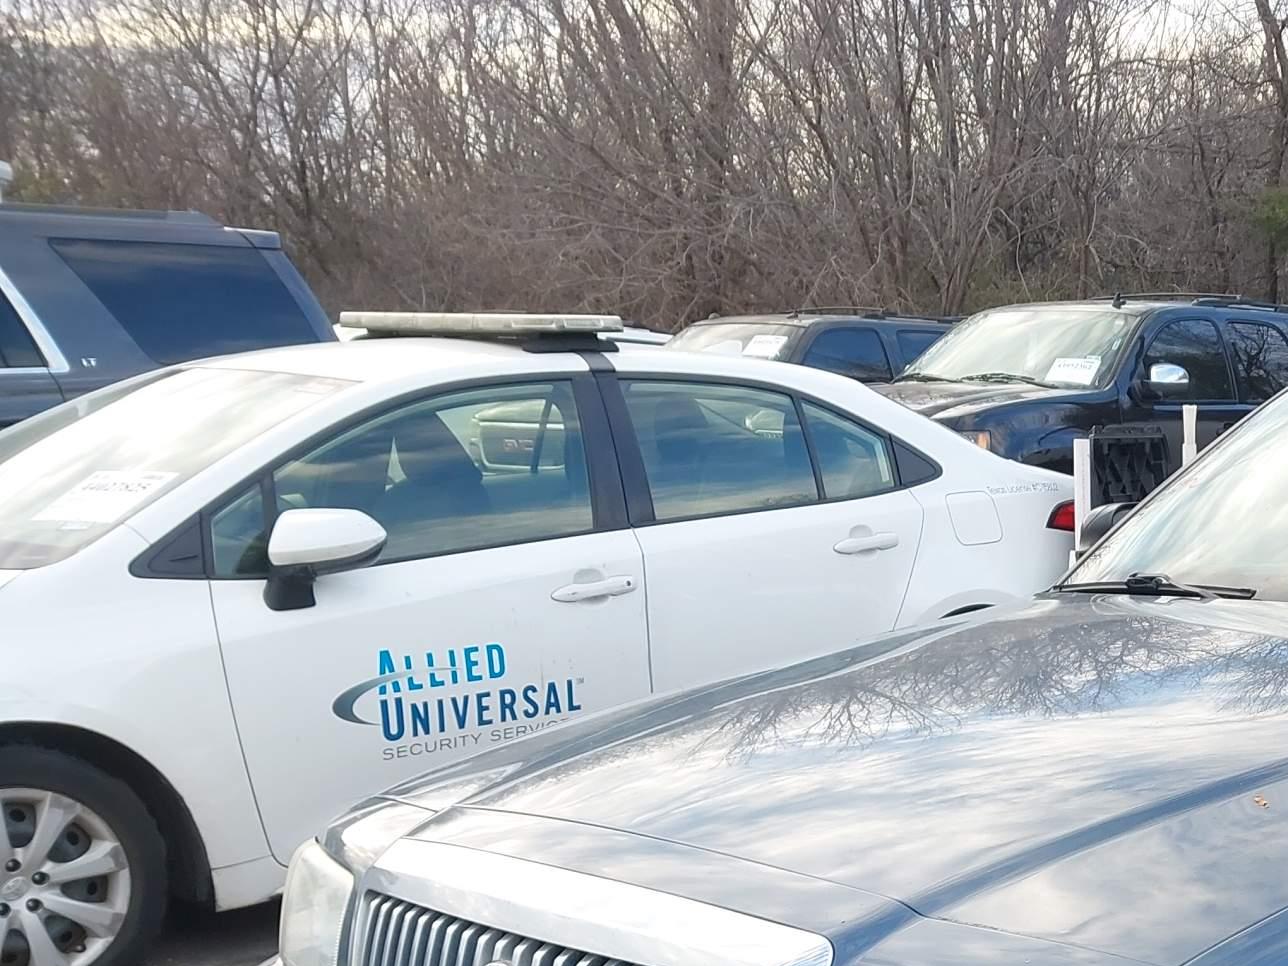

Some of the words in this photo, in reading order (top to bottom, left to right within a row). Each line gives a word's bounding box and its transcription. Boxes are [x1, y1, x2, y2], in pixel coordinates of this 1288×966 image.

[378, 643, 506, 695] ALLIED
[379, 679, 582, 742] UNIVERSAL
[382, 732, 483, 761] SECURITY
